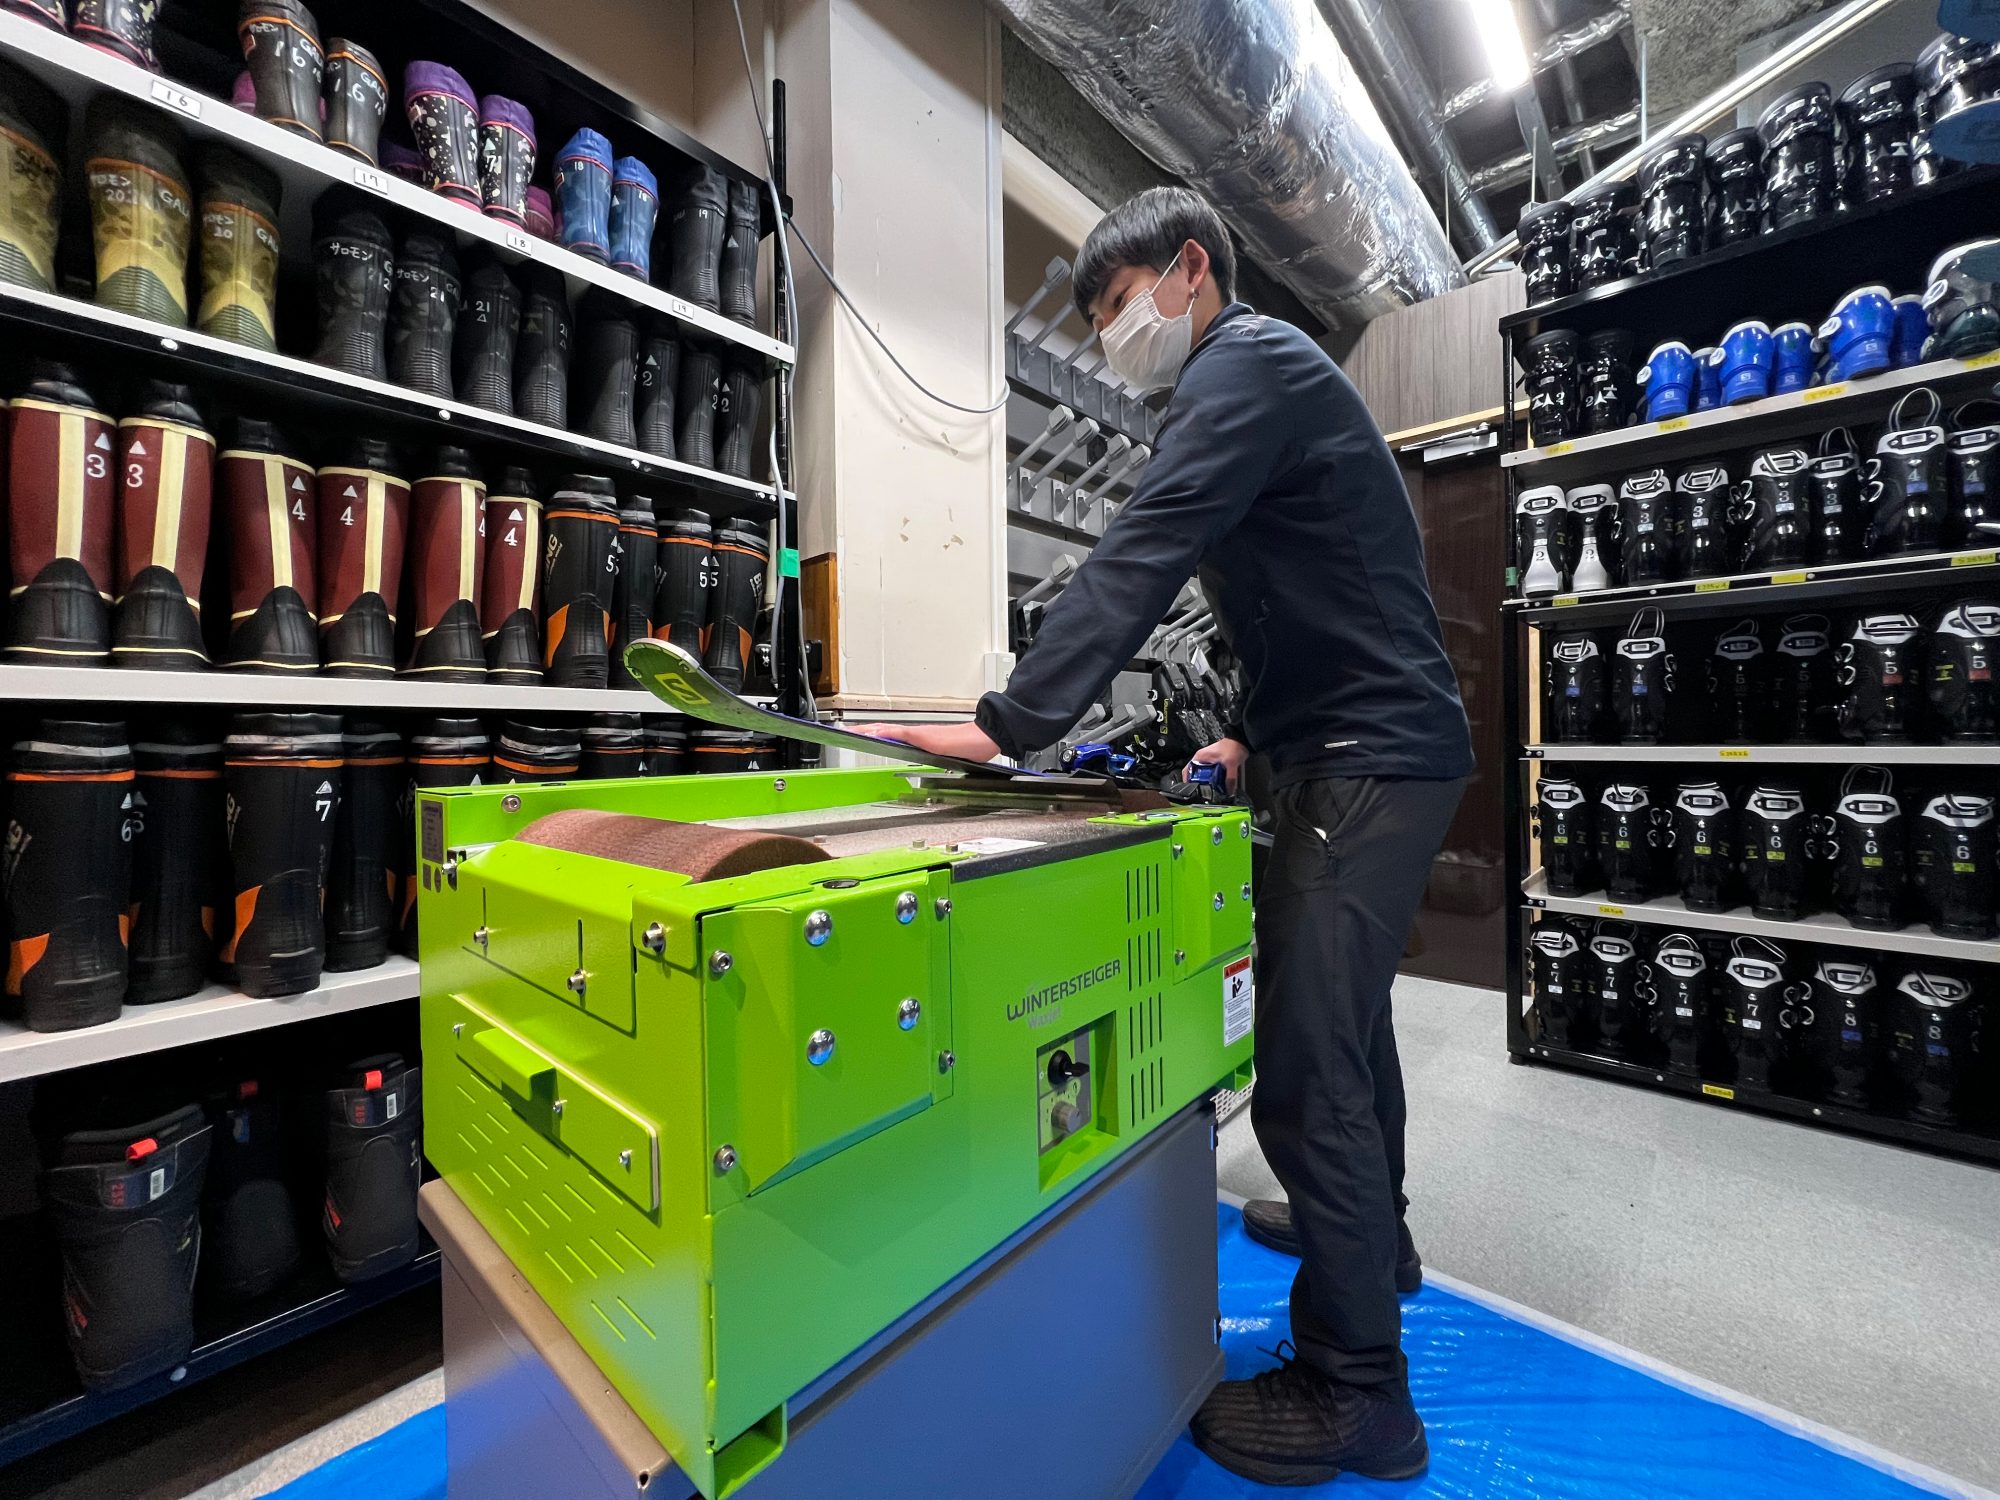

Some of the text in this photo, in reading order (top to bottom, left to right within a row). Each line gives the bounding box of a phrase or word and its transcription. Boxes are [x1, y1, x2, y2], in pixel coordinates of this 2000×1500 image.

[167, 90, 188, 107] 16
[363, 173, 378, 187] 17
[699, 208, 708, 219] 19
[514, 236, 526, 247] 18
[329, 242, 373, 262] サロモン
[429, 286, 445, 303] 21
[475, 300, 490, 313] 21
[642, 370, 653, 387] 2
[721, 398, 730, 413] 2
[87, 453, 106, 479] 3
[126, 463, 143, 488] 3
[1908, 468, 1921, 482] 4
[1966, 469, 1980, 482] 4
[1778, 490, 1790, 503] 3
[1826, 493, 1838, 505] 3
[291, 498, 307, 521] 4
[340, 505, 355, 526] 4
[1692, 505, 1704, 518] 3
[1641, 512, 1650, 524] 3
[503, 527, 518, 547] 4
[1536, 551, 1545, 561] 2
[605, 554, 616, 573] 5
[699, 571, 708, 588] 5
[710, 571, 719, 587] 5
[1885, 661, 1898, 674] 5
[1972, 655, 1987, 669] 5
[1568, 675, 1577, 687] 4
[1633, 673, 1643, 684] 4
[315, 800, 332, 822] 7
[121, 818, 132, 843] 6
[1557, 823, 1566, 835] 6
[1618, 826, 1628, 838] 6
[1696, 830, 1706, 843] 6
[1770, 835, 1782, 848] 6
[1865, 840, 1878, 854] 6
[1956, 845, 1970, 860] 6
[1550, 971, 1559, 983] 7
[1605, 976, 1615, 988] 7
[1006, 959, 1121, 1022] WINTERSTEIGER
[1678, 991, 1689, 1005] 7
[1747, 1003, 1758, 1017] 7
[1844, 1012, 1857, 1027] 8
[1929, 1025, 1942, 1040] 8
